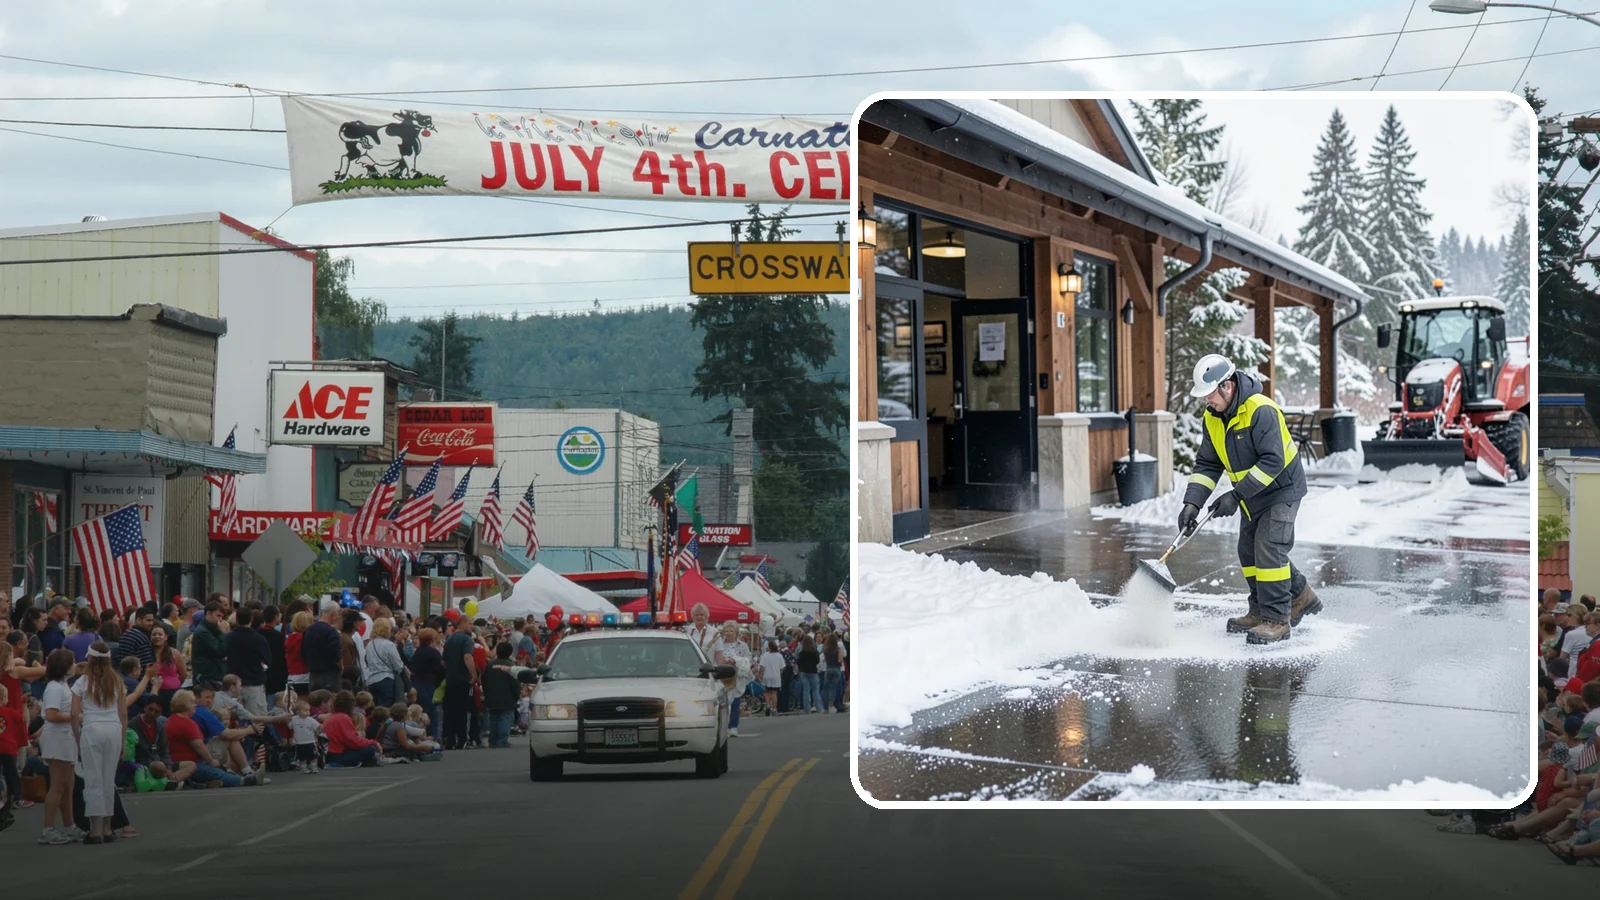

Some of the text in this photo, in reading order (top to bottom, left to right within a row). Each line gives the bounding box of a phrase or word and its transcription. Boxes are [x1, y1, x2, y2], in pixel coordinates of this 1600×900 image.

[481, 141, 605, 192] JULY
[632, 150, 746, 197] 4th.
[697, 254, 850, 280] CROSSWA
[283, 380, 374, 420] ACE
[405, 409, 485, 422] CEDAR LOG
[283, 421, 371, 436] Hardware
[416, 428, 477, 447] Coca-Cola
[83, 485, 155, 495] St. Vincent de Paul
[699, 535, 730, 543] GLASS
